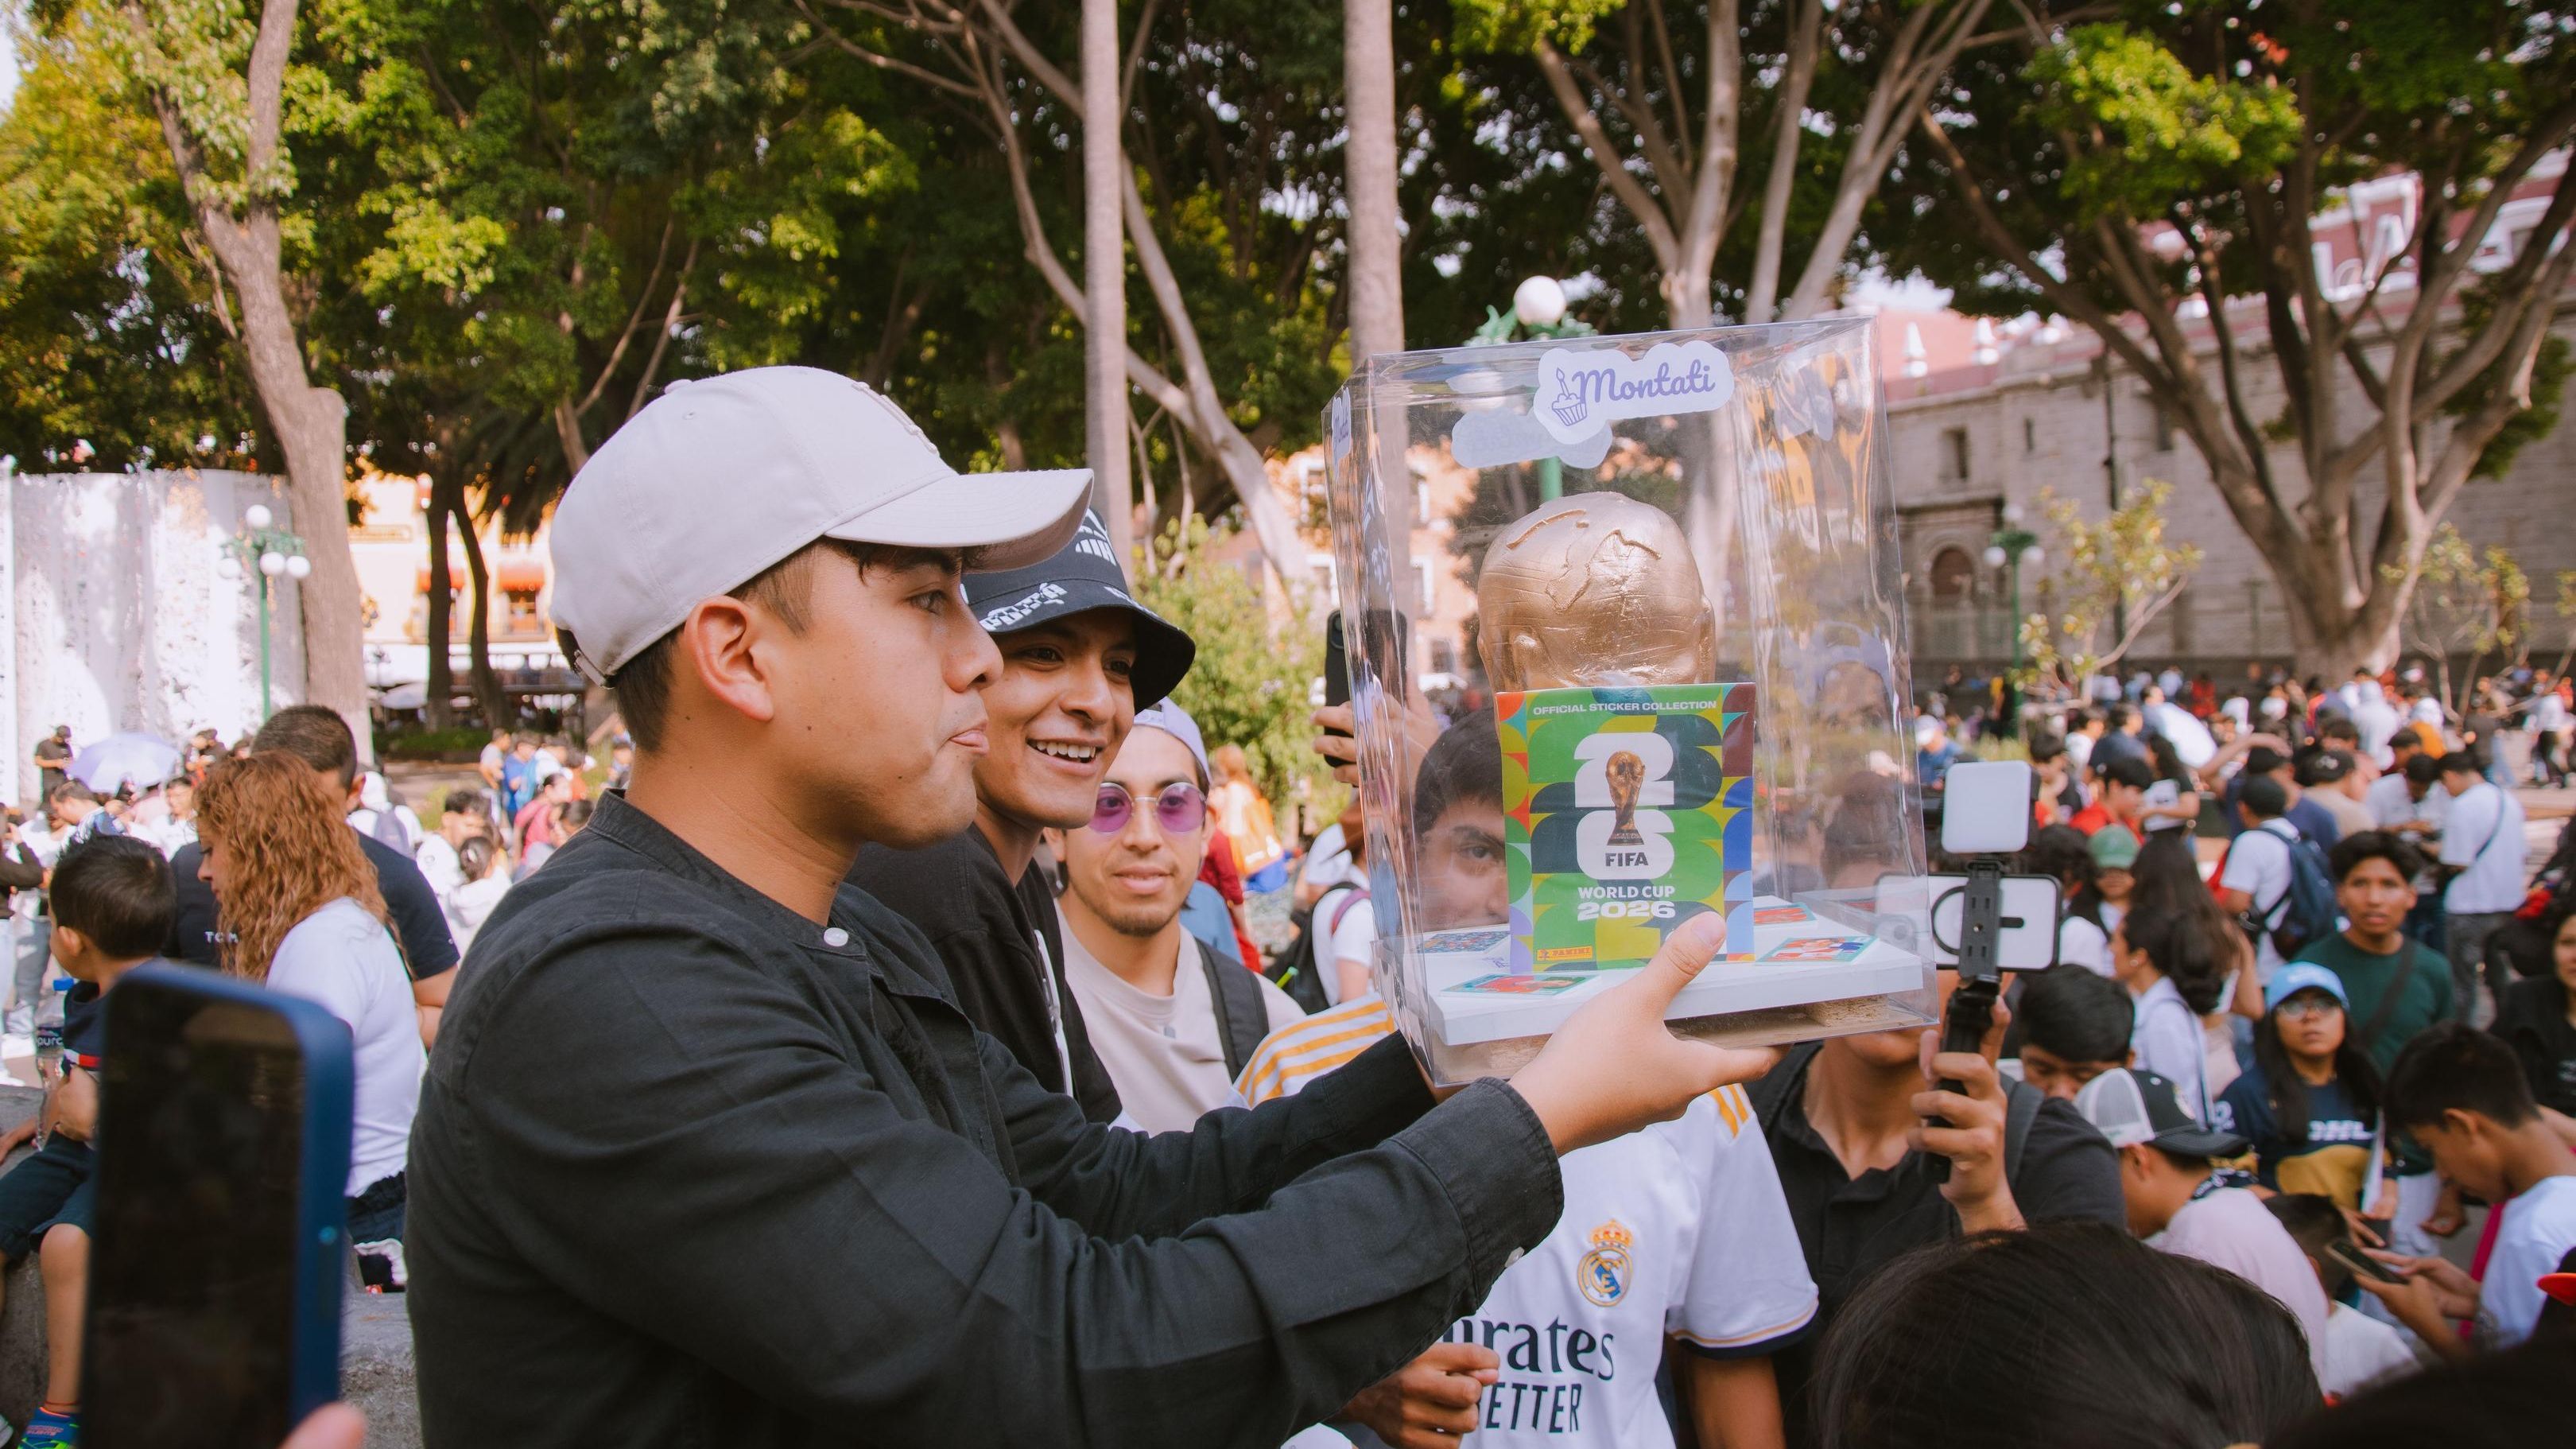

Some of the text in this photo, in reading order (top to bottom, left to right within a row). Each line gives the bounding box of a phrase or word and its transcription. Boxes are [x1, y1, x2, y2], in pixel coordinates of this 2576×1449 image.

[1572, 359, 1716, 403] Montati
[1533, 701, 1717, 715] OFFICIAL STICKER COLLECTION
[1604, 852, 1649, 867] FIFA
[1577, 885, 1676, 899] WORLD CUP
[1577, 899, 1676, 922] 2026
[1479, 1381, 1582, 1434] ETTER
